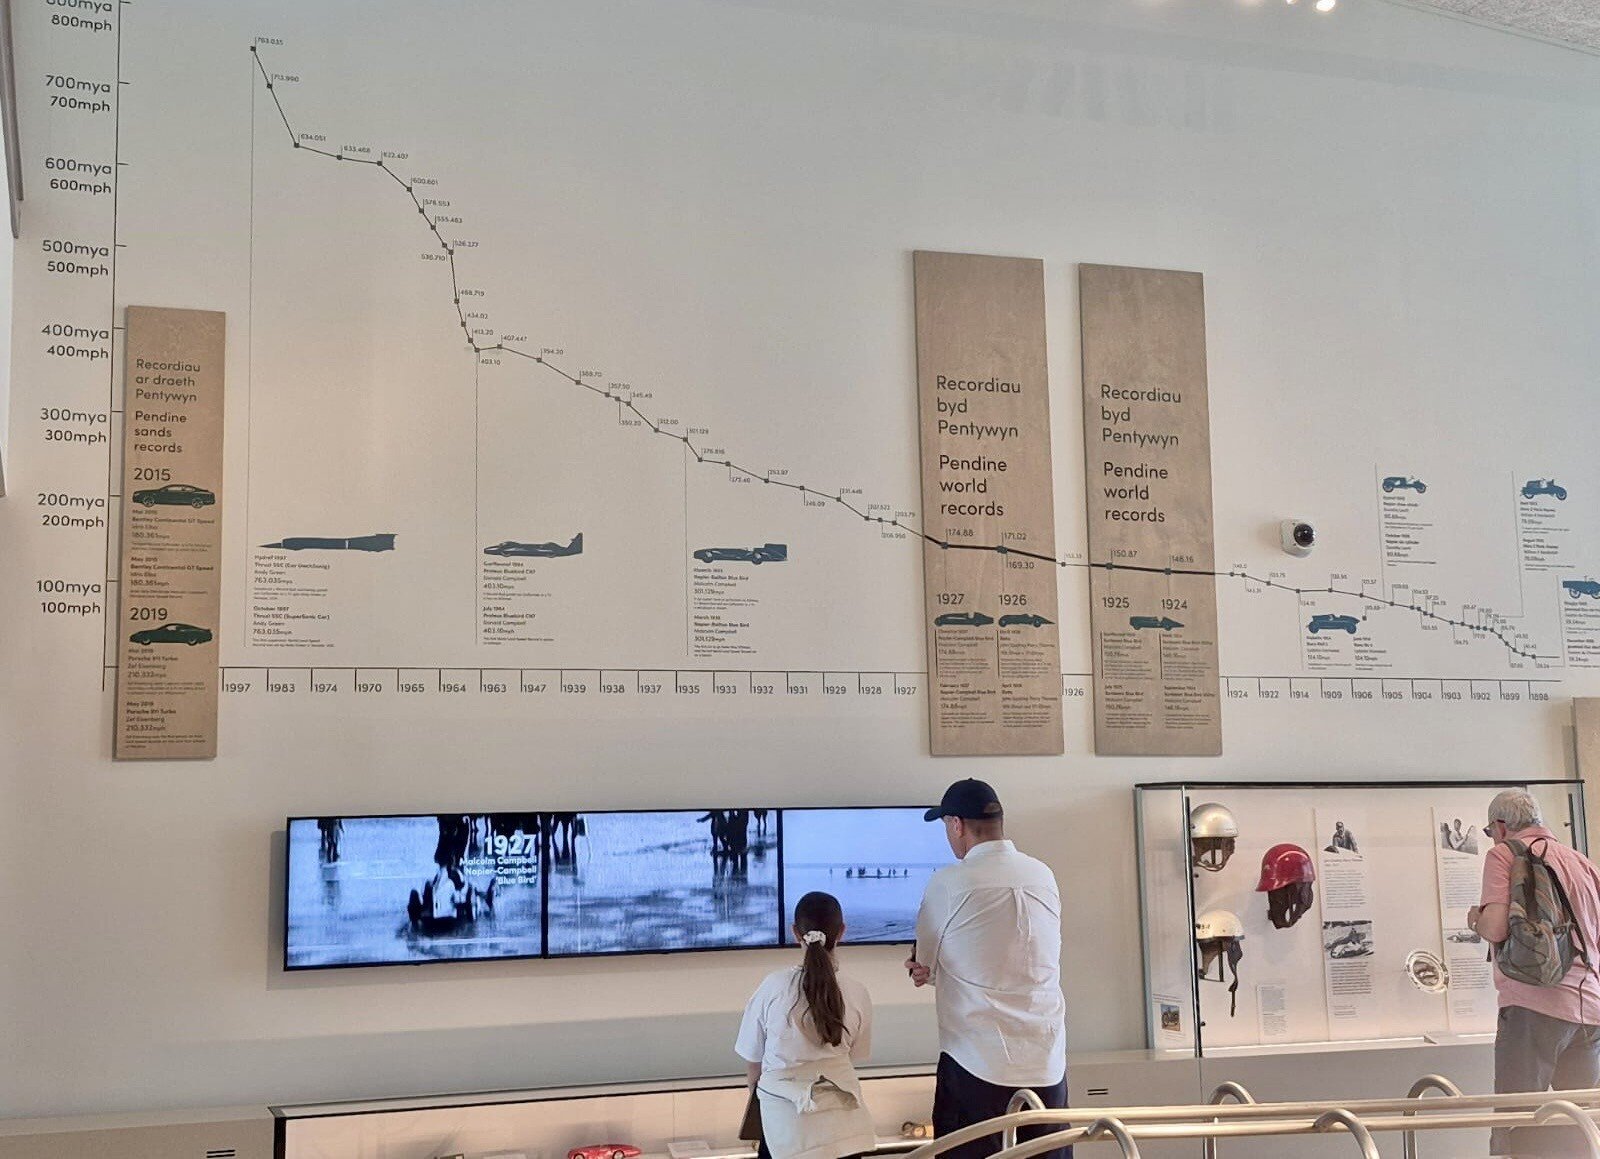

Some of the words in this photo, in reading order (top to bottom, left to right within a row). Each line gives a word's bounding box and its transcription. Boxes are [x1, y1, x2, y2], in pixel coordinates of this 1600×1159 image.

[52, 15, 112, 32] 800mph
[46, 75, 110, 94] 700mya
[50, 96, 110, 113] 700mph
[45, 157, 112, 176] 600mya
[50, 178, 112, 196] 600mph
[42, 240, 109, 258] 500mya
[48, 261, 108, 278] 500mph
[42, 324, 109, 342] 400mya
[47, 345, 108, 361] 400mph
[136, 358, 200, 372] Recordiau
[136, 376, 149, 384] ar
[154, 374, 196, 387] draeth
[936, 375, 1021, 394] Recordiau
[136, 389, 198, 404] Pentywyn
[1101, 384, 1181, 404] Recordiau
[936, 397, 968, 416] byd
[40, 408, 106, 425] 300mya
[135, 411, 187, 423] Pendine
[1101, 406, 1130, 424] byd
[134, 426, 172, 438] sands
[938, 420, 1019, 441] Pentywyn
[45, 430, 106, 445] 300mph
[1102, 428, 1180, 450] Pentywyn
[134, 442, 182, 453] records
[940, 455, 1008, 472] Pendine
[134, 468, 171, 482] 2015
[1104, 462, 1168, 480] Pendine
[940, 478, 988, 494] world
[1104, 485, 1150, 500] world
[38, 494, 105, 510] 200mya
[941, 501, 1004, 516] records
[1105, 508, 1166, 522] records
[42, 515, 104, 530] 200mph
[36, 580, 102, 596] 100mya
[936, 593, 965, 605] 1927
[998, 594, 1028, 606] 1926
[1102, 596, 1130, 609] 1925
[1161, 598, 1188, 610] 1924
[41, 602, 101, 617] 100mph
[130, 607, 168, 621] 2019
[226, 682, 250, 693] 1997
[270, 682, 296, 693] 1983
[314, 683, 338, 693] 1974
[358, 683, 382, 693] 1970
[400, 684, 424, 692] 1965
[442, 684, 466, 693] 1964
[483, 684, 506, 693] 1963
[523, 684, 546, 693] 1947
[563, 684, 586, 694] 1939
[602, 685, 625, 694] 1938
[640, 684, 662, 694] 1937
[678, 684, 700, 694] 1935
[716, 684, 737, 694] 1933
[752, 685, 774, 694] 1932
[789, 685, 808, 694] 1931
[826, 685, 846, 694] 1929
[861, 686, 882, 694] 1928
[897, 686, 917, 694] 1927
[1064, 688, 1084, 697] 1926
[1230, 690, 1248, 698] 1924
[1261, 690, 1279, 699] 1922
[1292, 691, 1310, 699] 1914
[1324, 691, 1342, 699] 1909
[1384, 692, 1403, 700] 1905
[1414, 692, 1432, 700] 1904
[1443, 692, 1462, 700] 1903
[1472, 692, 1491, 700] 1902
[1501, 692, 1520, 700] 1899
[485, 834, 536, 855] 1927
[460, 857, 496, 866] Malcolm
[496, 856, 537, 866] Campbell
